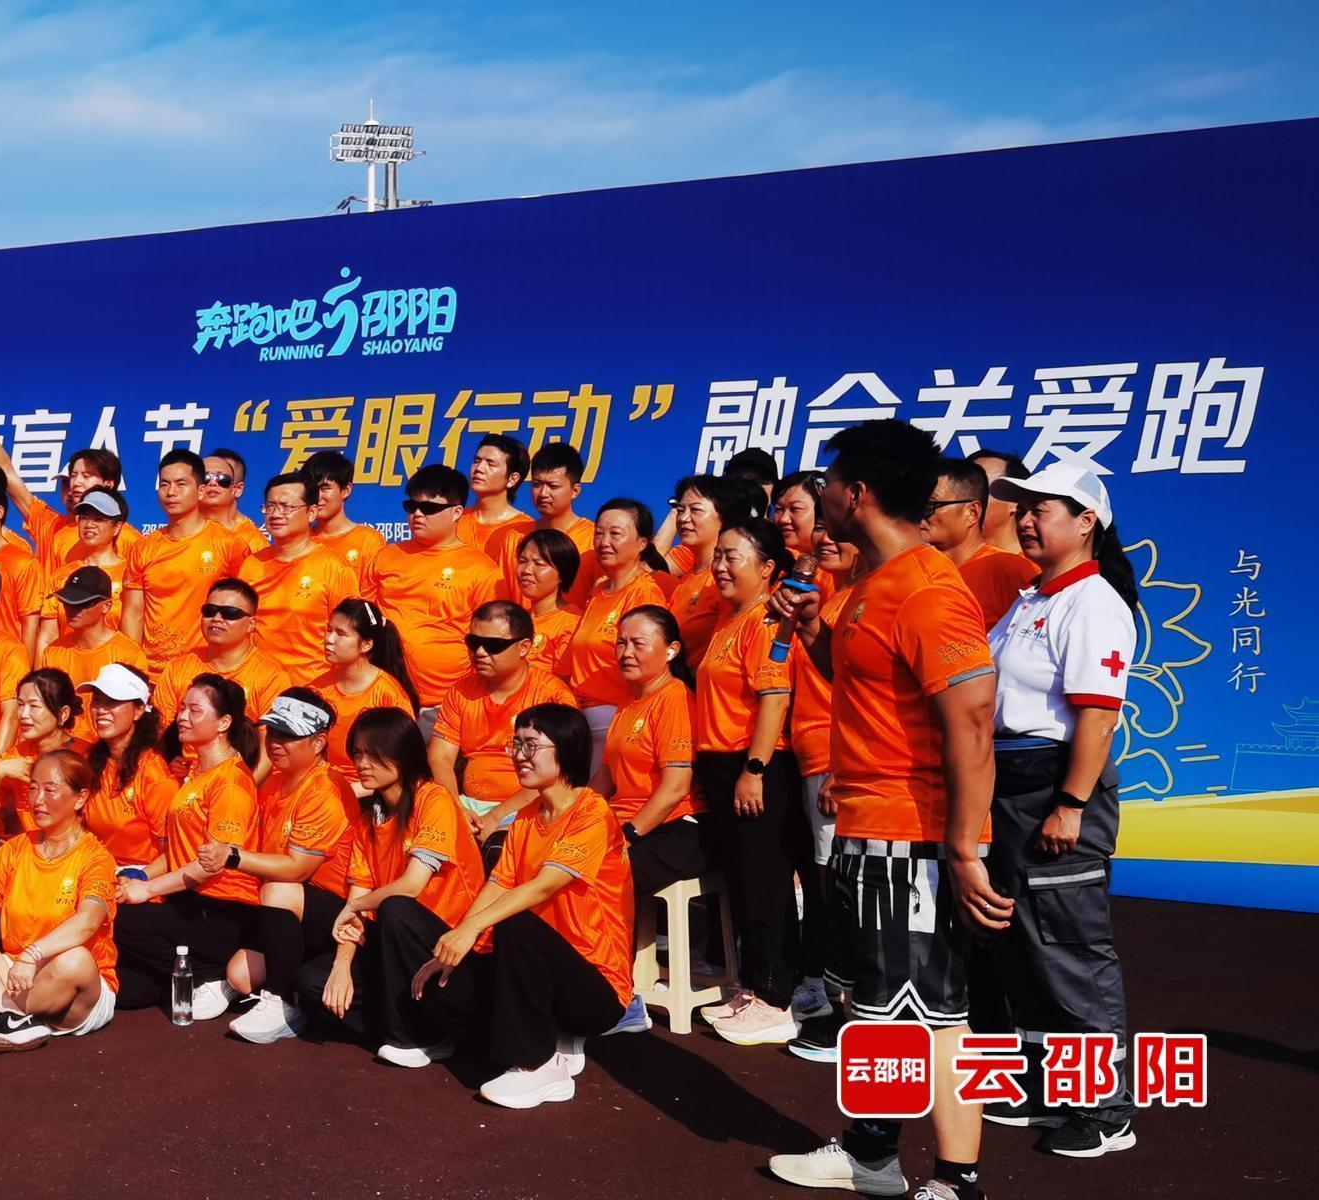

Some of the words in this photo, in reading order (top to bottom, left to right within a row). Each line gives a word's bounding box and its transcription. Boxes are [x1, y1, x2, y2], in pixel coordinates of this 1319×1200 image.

[192, 300, 323, 354] 奔跑吧
[361, 286, 457, 338] 邵阳
[259, 343, 325, 362] RUNNING
[361, 336, 444, 356] SHAOYANG
[1227, 549, 1266, 694] 与光同行
